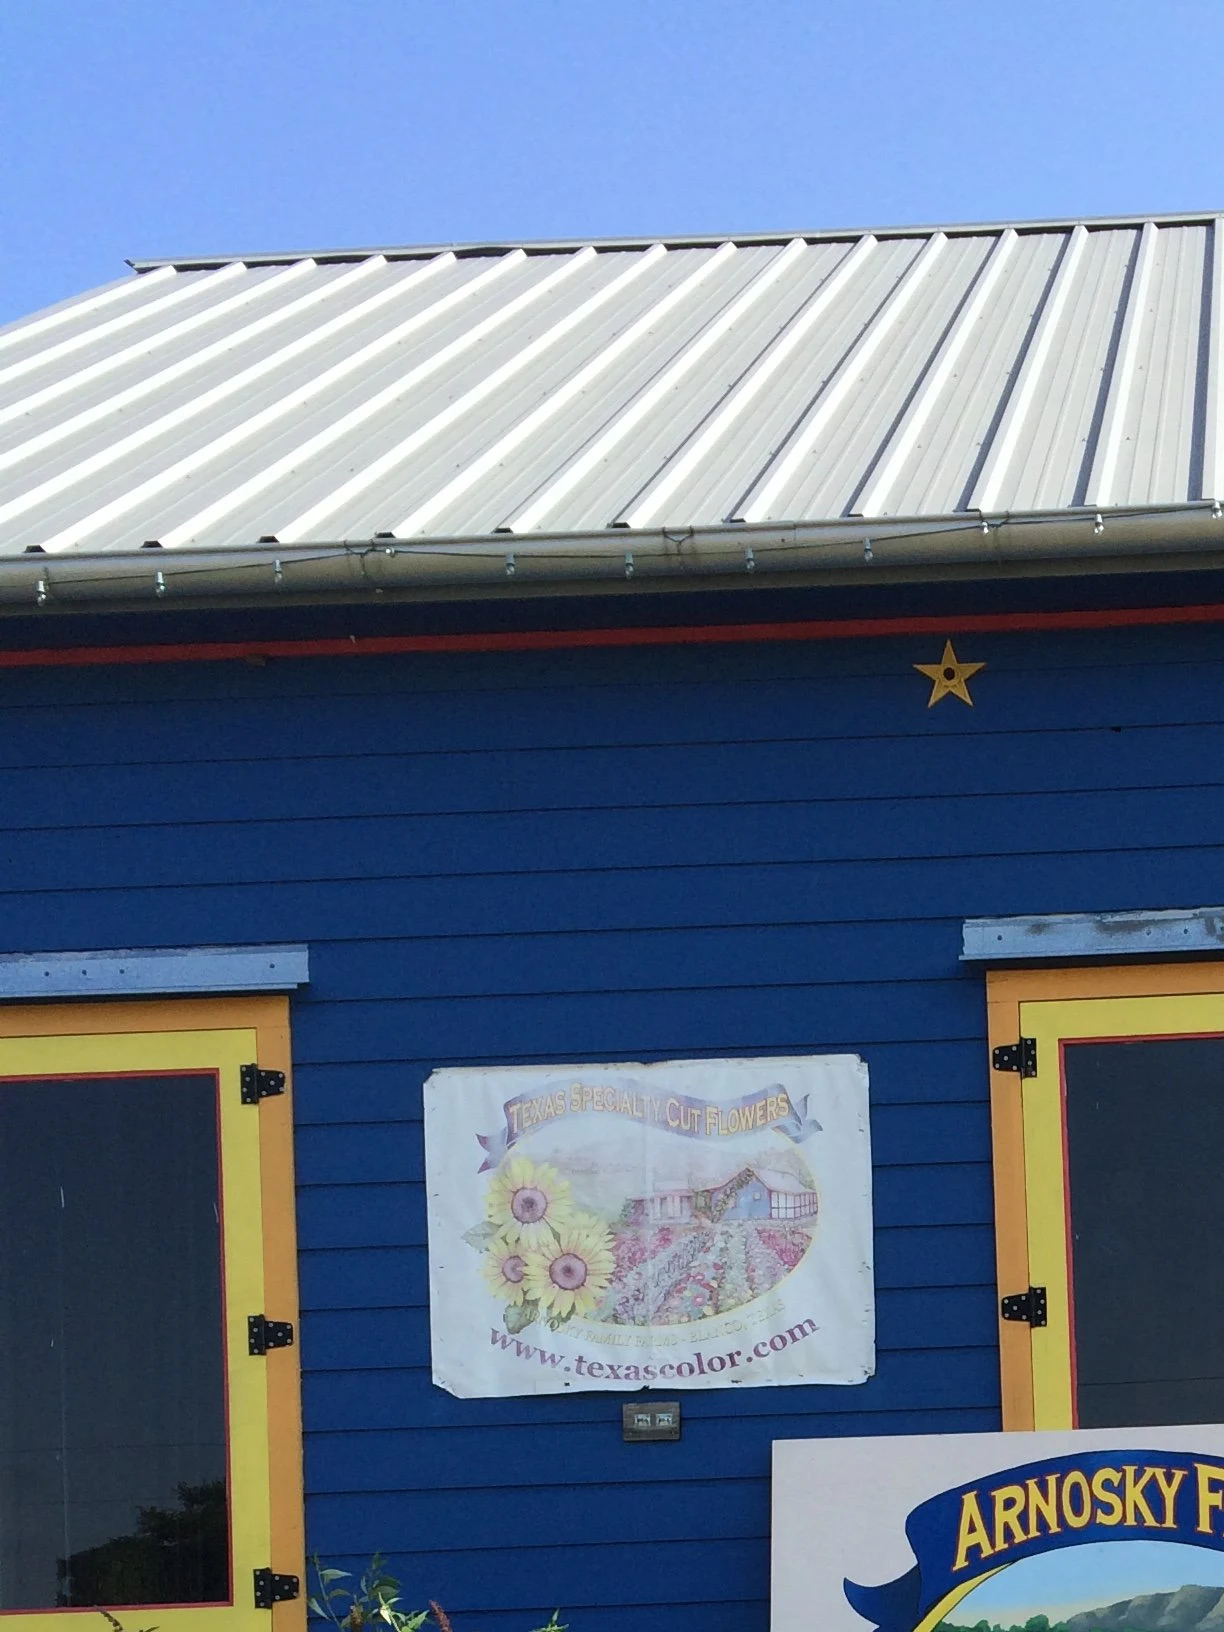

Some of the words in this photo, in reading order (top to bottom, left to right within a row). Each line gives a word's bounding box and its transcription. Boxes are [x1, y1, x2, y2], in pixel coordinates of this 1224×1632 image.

[508, 1090, 566, 1134] TEXAS
[569, 1082, 662, 1122] SPECIALTY
[665, 1098, 702, 1132] CUT
[704, 1093, 790, 1136] FLOWERS
[490, 1316, 820, 1381] www.texascolor.com
[952, 1465, 1189, 1572] ARNOSKY
